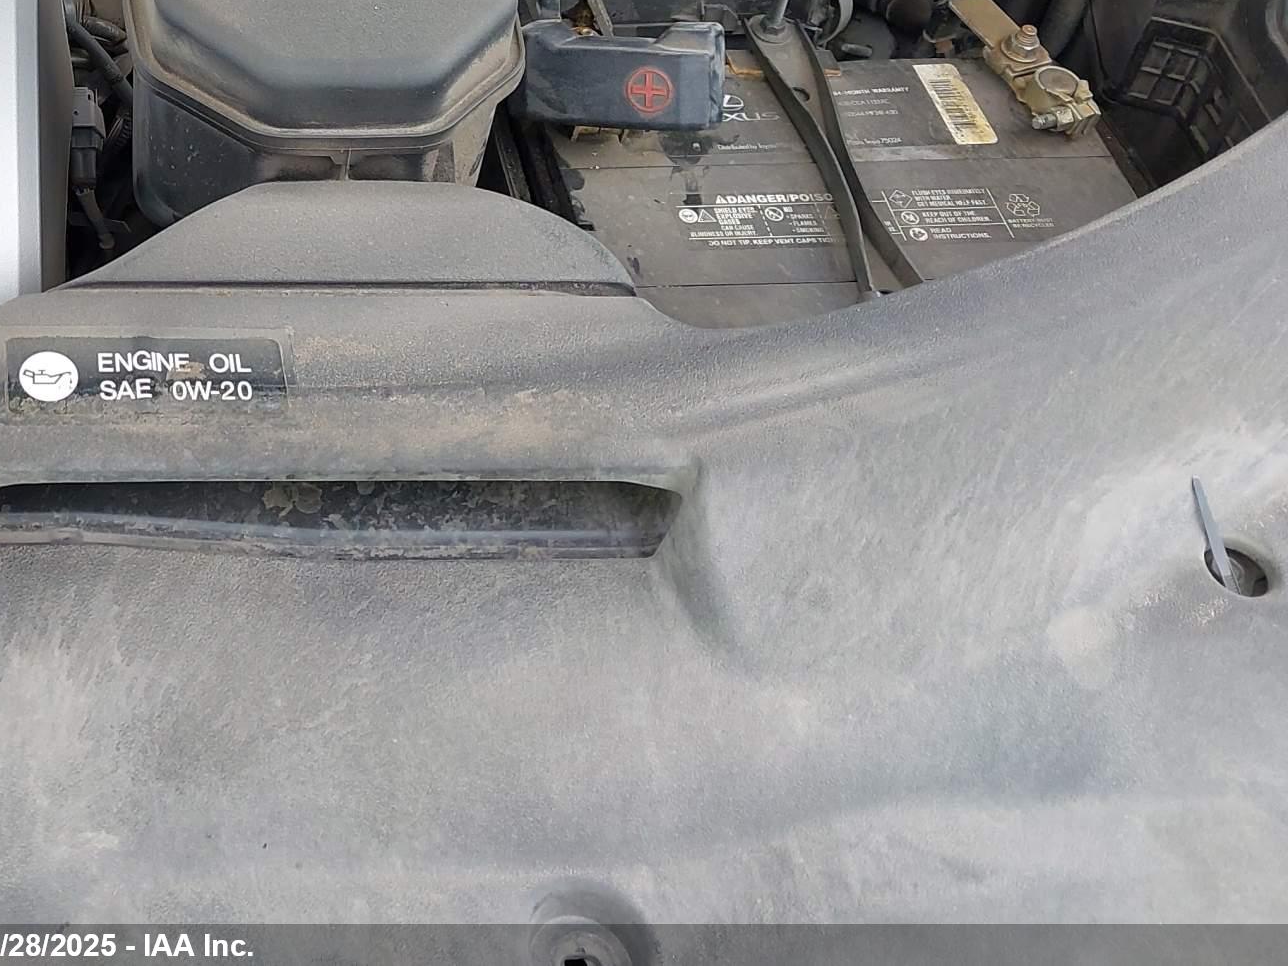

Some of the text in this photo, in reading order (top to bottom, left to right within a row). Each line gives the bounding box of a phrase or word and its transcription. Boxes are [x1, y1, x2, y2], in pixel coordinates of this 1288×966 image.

[722, 112, 781, 122] XUS
[726, 193, 833, 204] DANGER/POISO
[97, 351, 252, 373] ENGINE OIL
[100, 378, 253, 401] SAE 0W-20
